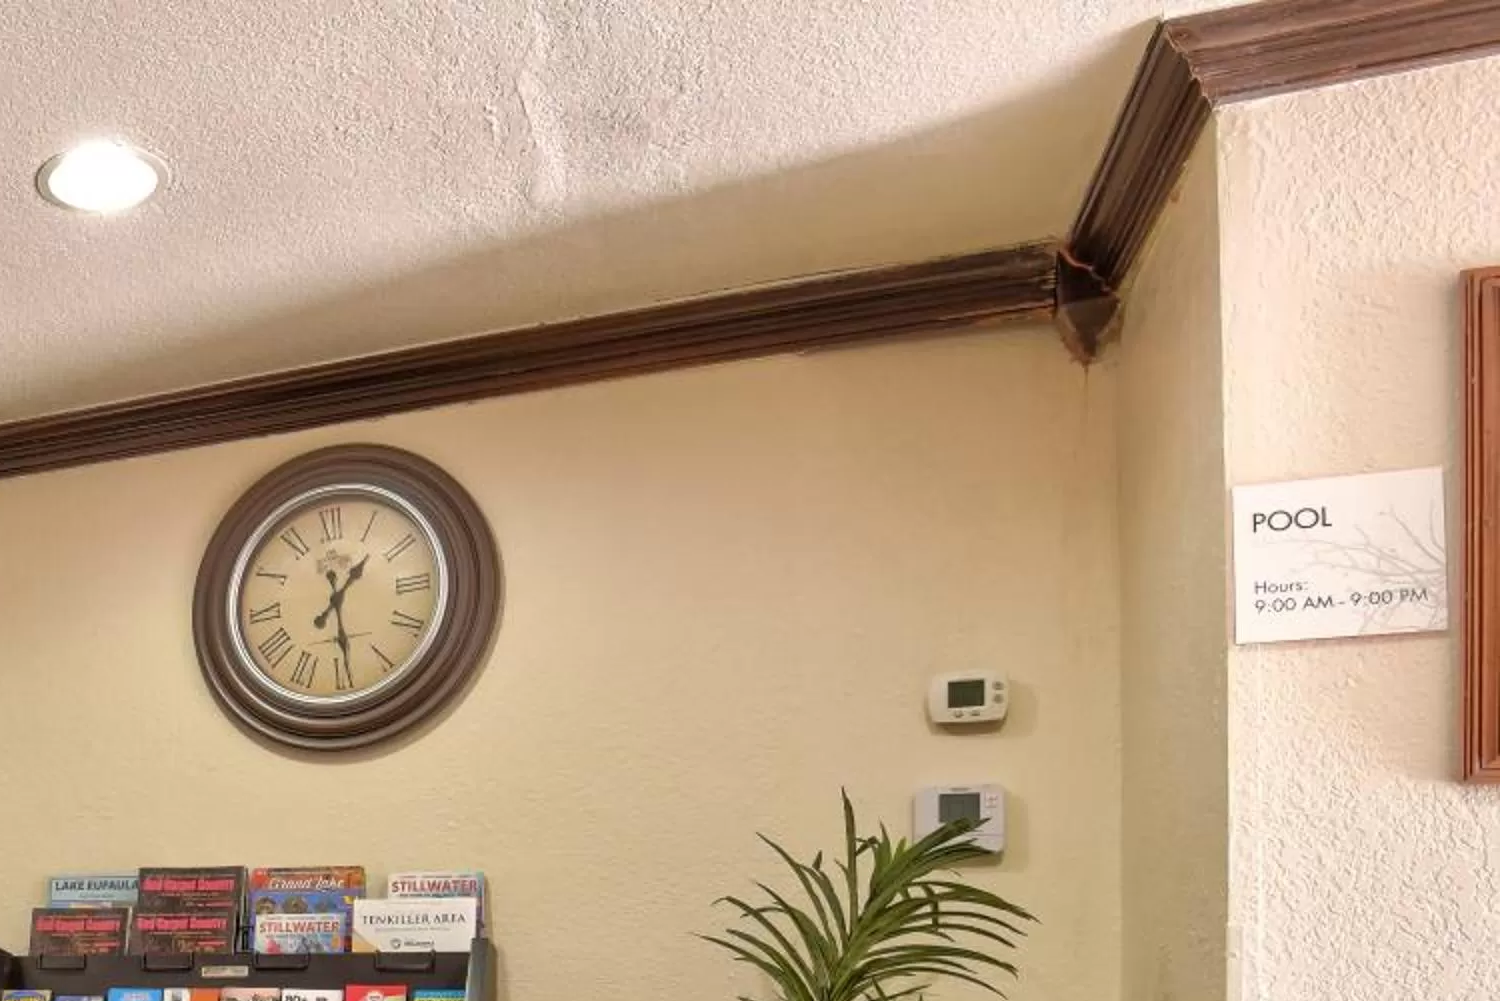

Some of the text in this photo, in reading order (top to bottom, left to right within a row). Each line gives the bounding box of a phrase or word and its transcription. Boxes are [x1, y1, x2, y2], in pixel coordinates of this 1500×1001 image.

[1252, 506, 1333, 533] POOL
[1254, 581, 1309, 595] Hours:
[1254, 597, 1296, 613] 9:00
[1302, 595, 1334, 610] AM
[1350, 588, 1393, 607] 9:00
[1399, 587, 1429, 602] PM
[391, 878, 478, 894] STILLWATER
[434, 913, 467, 924] AREA
[260, 920, 340, 934] STILLWATER
